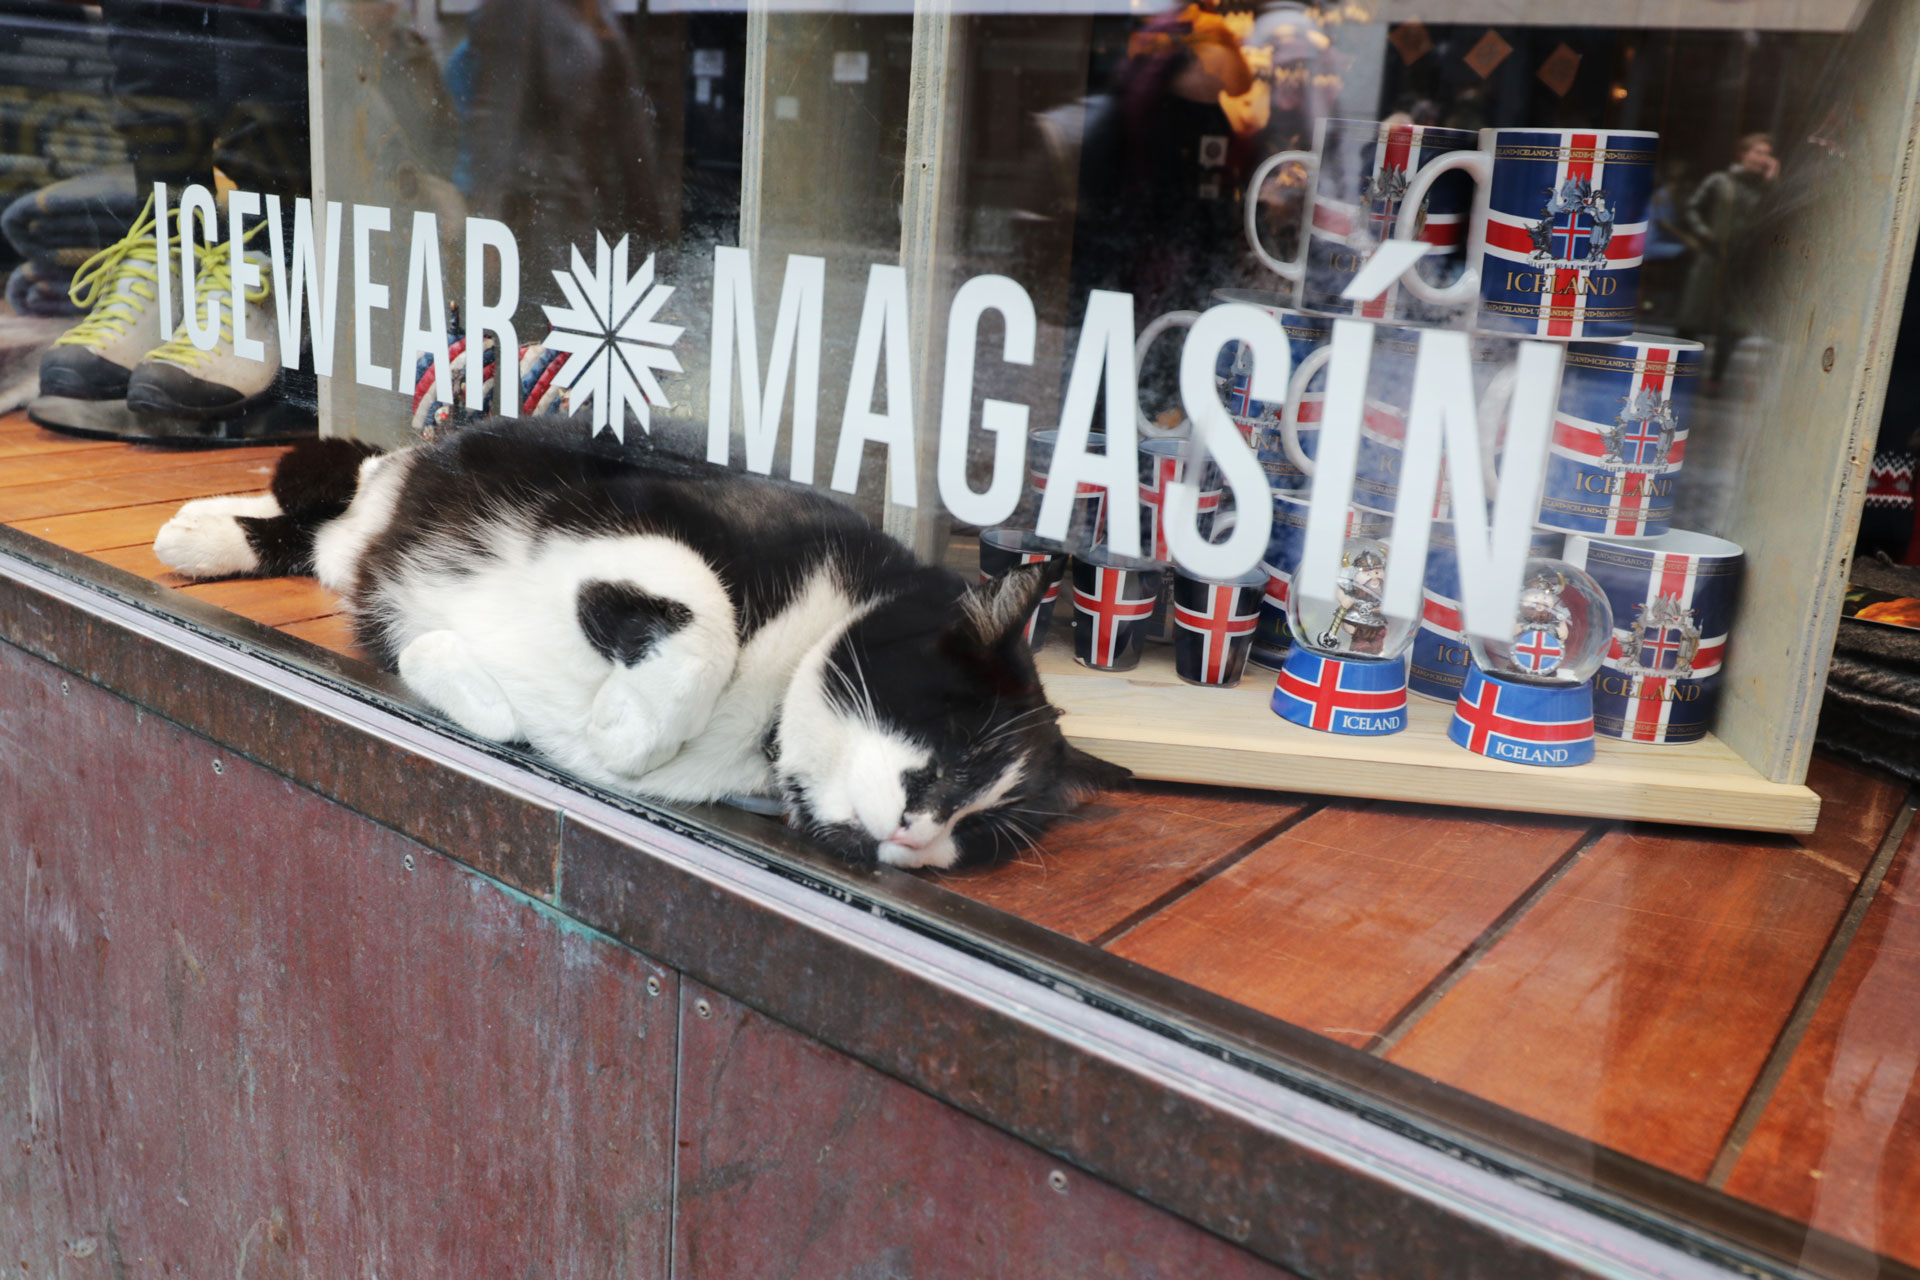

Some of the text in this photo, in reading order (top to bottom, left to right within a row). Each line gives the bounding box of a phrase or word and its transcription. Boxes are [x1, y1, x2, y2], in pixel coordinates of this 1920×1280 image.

[1505, 271, 1617, 296] ICELAND
[154, 181, 1565, 641] ICEWEAR MAGASÍN
[1575, 472, 1673, 497] ICELAND
[1594, 674, 1700, 701] ICELAND
[1342, 715, 1400, 731] ICELAND
[1495, 741, 1568, 762] ICELAND
